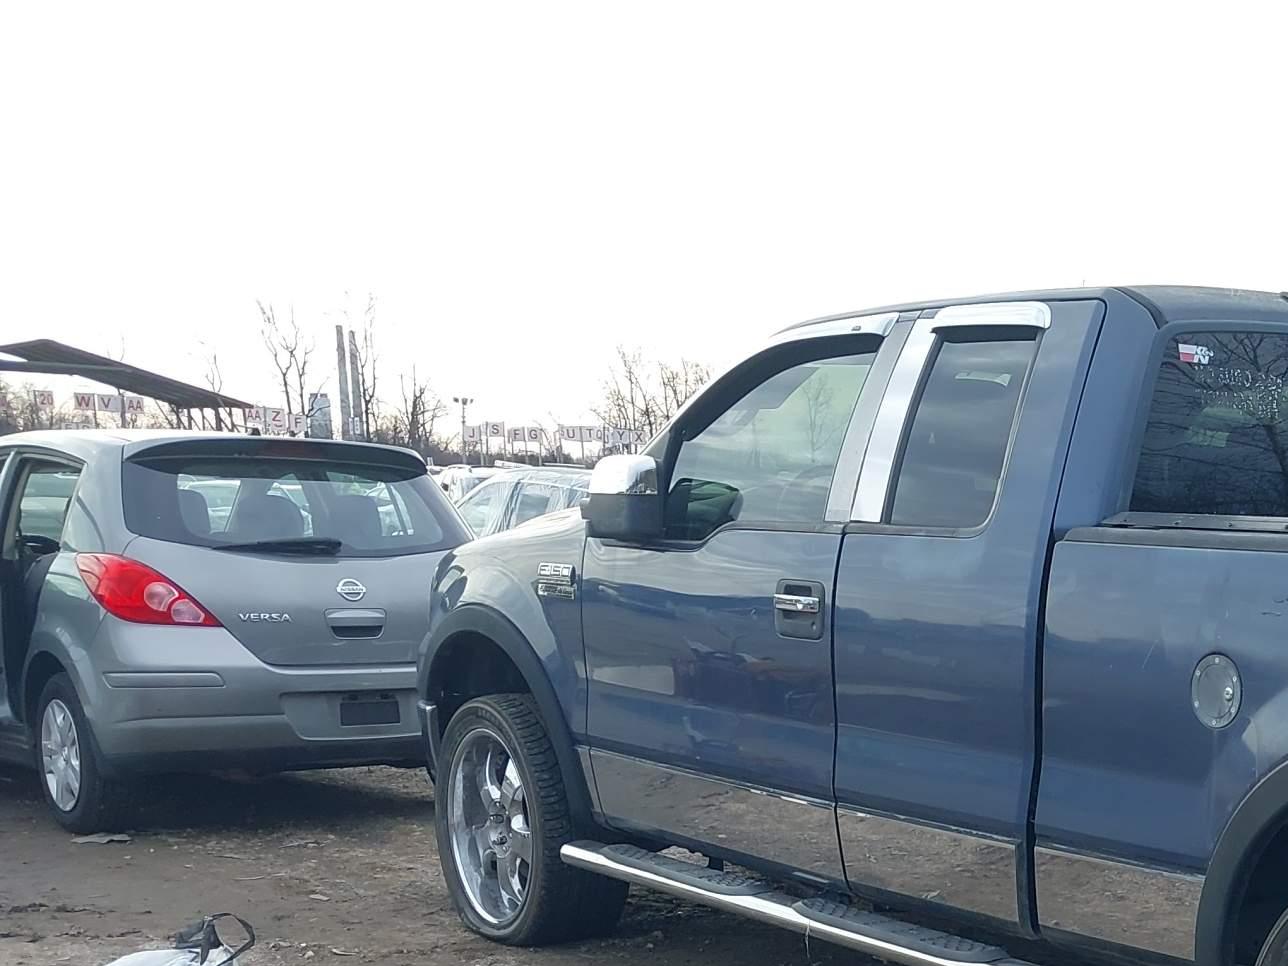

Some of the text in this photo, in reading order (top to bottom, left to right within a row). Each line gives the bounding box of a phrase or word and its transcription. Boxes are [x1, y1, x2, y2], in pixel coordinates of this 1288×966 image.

[77, 395, 91, 408] W
[101, 398, 112, 409] V
[127, 400, 144, 412] AA
[247, 410, 261, 421] AA
[271, 411, 281, 422] Z
[294, 417, 302, 428] F
[468, 428, 476, 439] J
[491, 424, 500, 435] S
[513, 429, 520, 440] F
[529, 428, 538, 440] G
[566, 428, 575, 439] U
[586, 428, 594, 439] T
[616, 431, 626, 441] Y
[634, 432, 644, 443] X
[238, 612, 293, 623] VERSA
